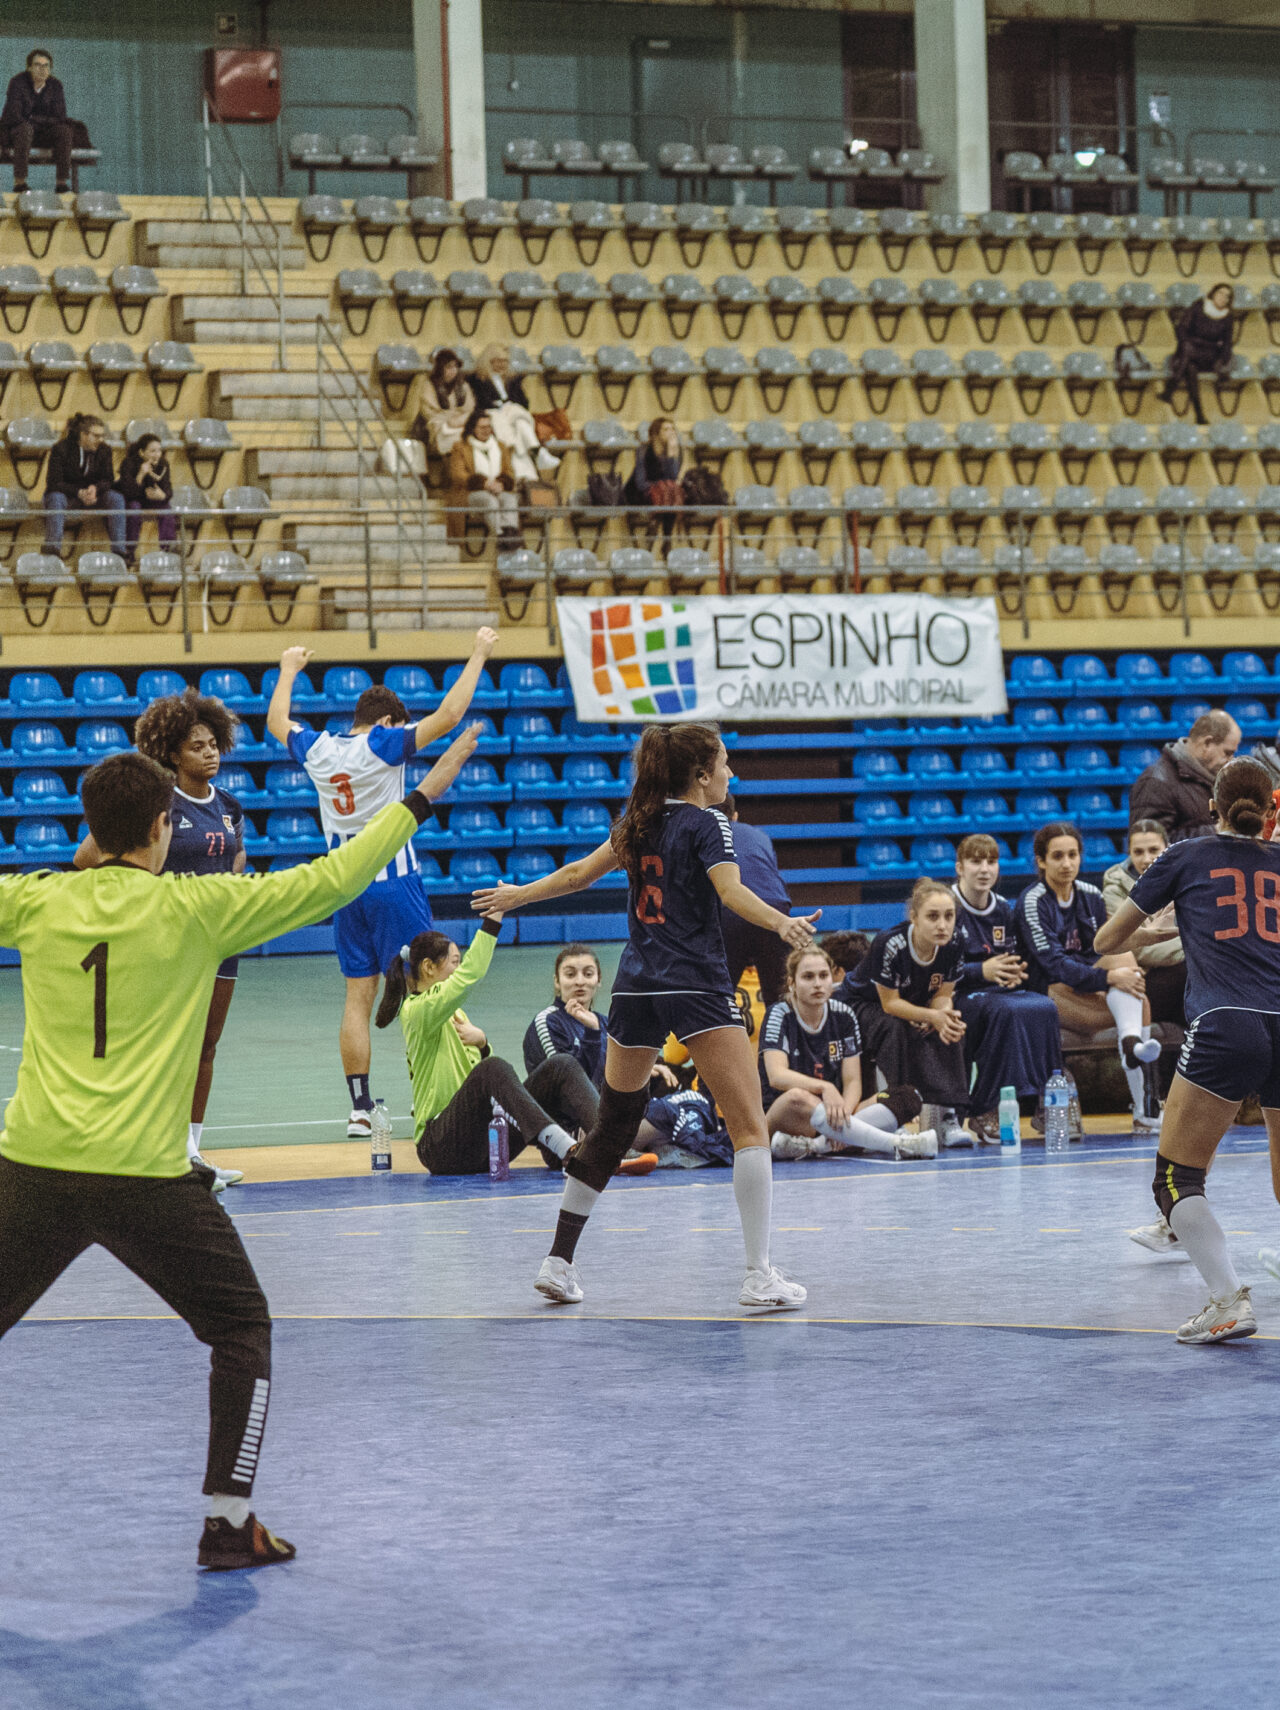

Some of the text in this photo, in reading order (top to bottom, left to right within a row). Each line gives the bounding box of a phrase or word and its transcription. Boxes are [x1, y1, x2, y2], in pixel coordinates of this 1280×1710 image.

[712, 611, 970, 670] ESPINHO
[716, 674, 973, 708] CÂMARA MUNICIPAL
[329, 773, 366, 816] 3
[205, 831, 225, 857] 27
[636, 855, 667, 925] 6
[80, 941, 109, 1059] 1
